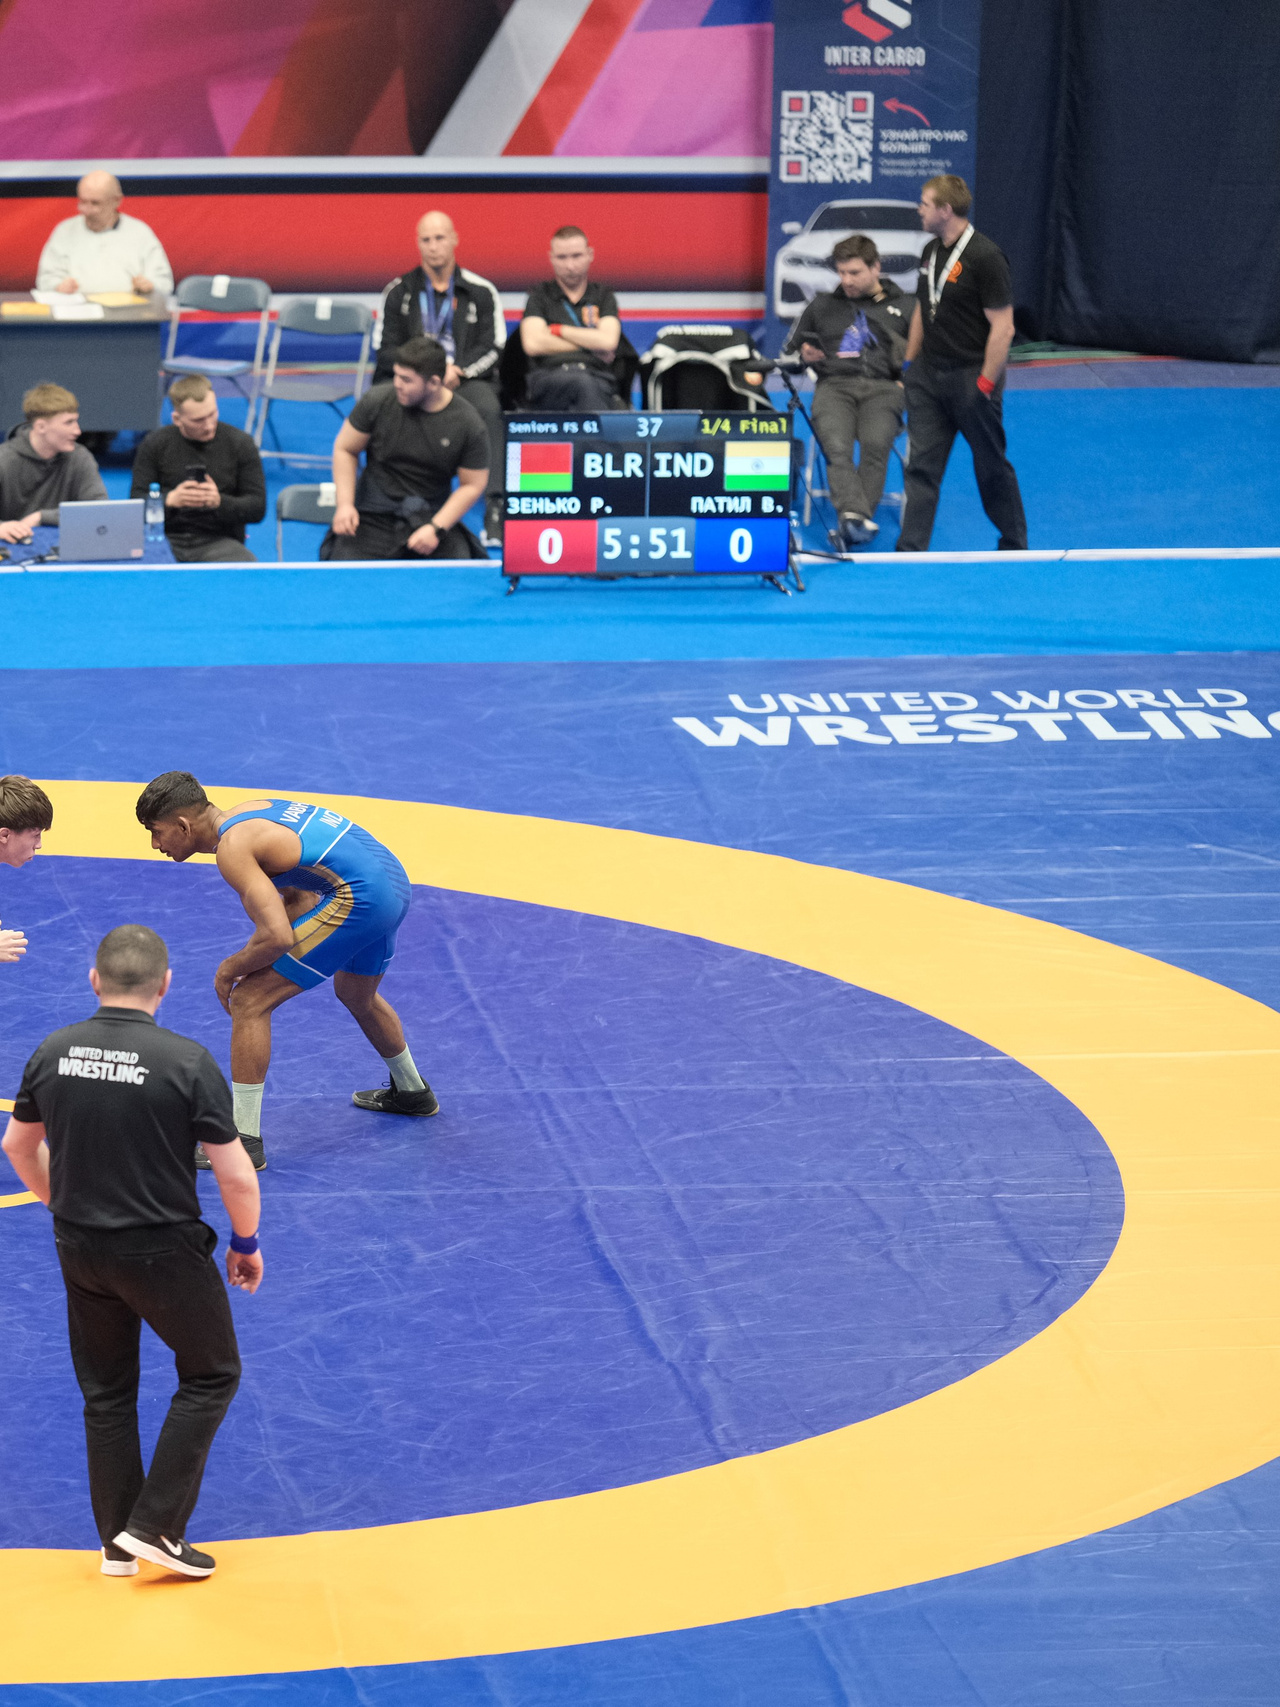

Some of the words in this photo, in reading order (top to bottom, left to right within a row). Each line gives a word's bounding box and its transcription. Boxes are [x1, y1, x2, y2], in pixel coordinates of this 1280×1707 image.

[824, 45, 871, 66] INTER
[873, 45, 926, 66] CARGO
[508, 420, 559, 433] Seniors
[563, 421, 579, 433] FS
[583, 420, 600, 433] 61
[636, 417, 663, 437] 37
[701, 417, 732, 436] 1/4
[739, 417, 787, 434] Final
[583, 452, 644, 478] BLR
[653, 452, 714, 478] IND
[506, 496, 581, 514] ЗЕНЬКО
[690, 495, 752, 513] ПАТИЛ
[538, 527, 563, 564] 0
[603, 527, 692, 560] 5:51
[729, 527, 753, 563] 0
[728, 691, 978, 713] UNITED
[991, 688, 1248, 710] WORLD
[672, 709, 1280, 746] WRESTLIN
[68, 1045, 103, 1060] UNITED
[103, 1049, 139, 1065] WORLD
[58, 1057, 146, 1085] WRESTLING
